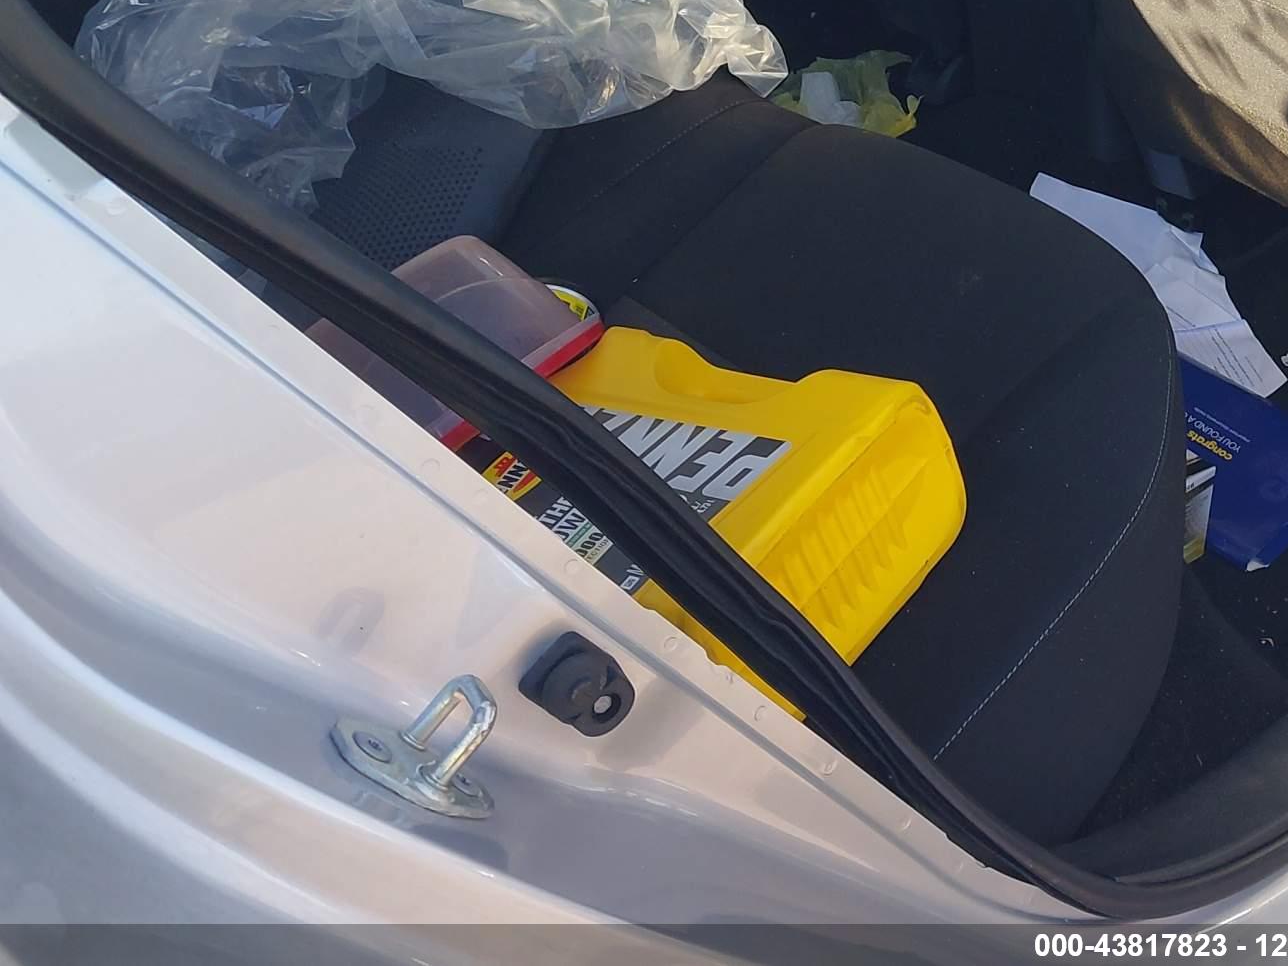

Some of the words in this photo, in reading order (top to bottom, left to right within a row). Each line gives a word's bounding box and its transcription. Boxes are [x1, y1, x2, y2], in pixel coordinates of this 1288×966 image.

[1192, 418, 1225, 443] FOUND
[1186, 429, 1234, 461] congrats
[1221, 436, 1242, 453] YOU
